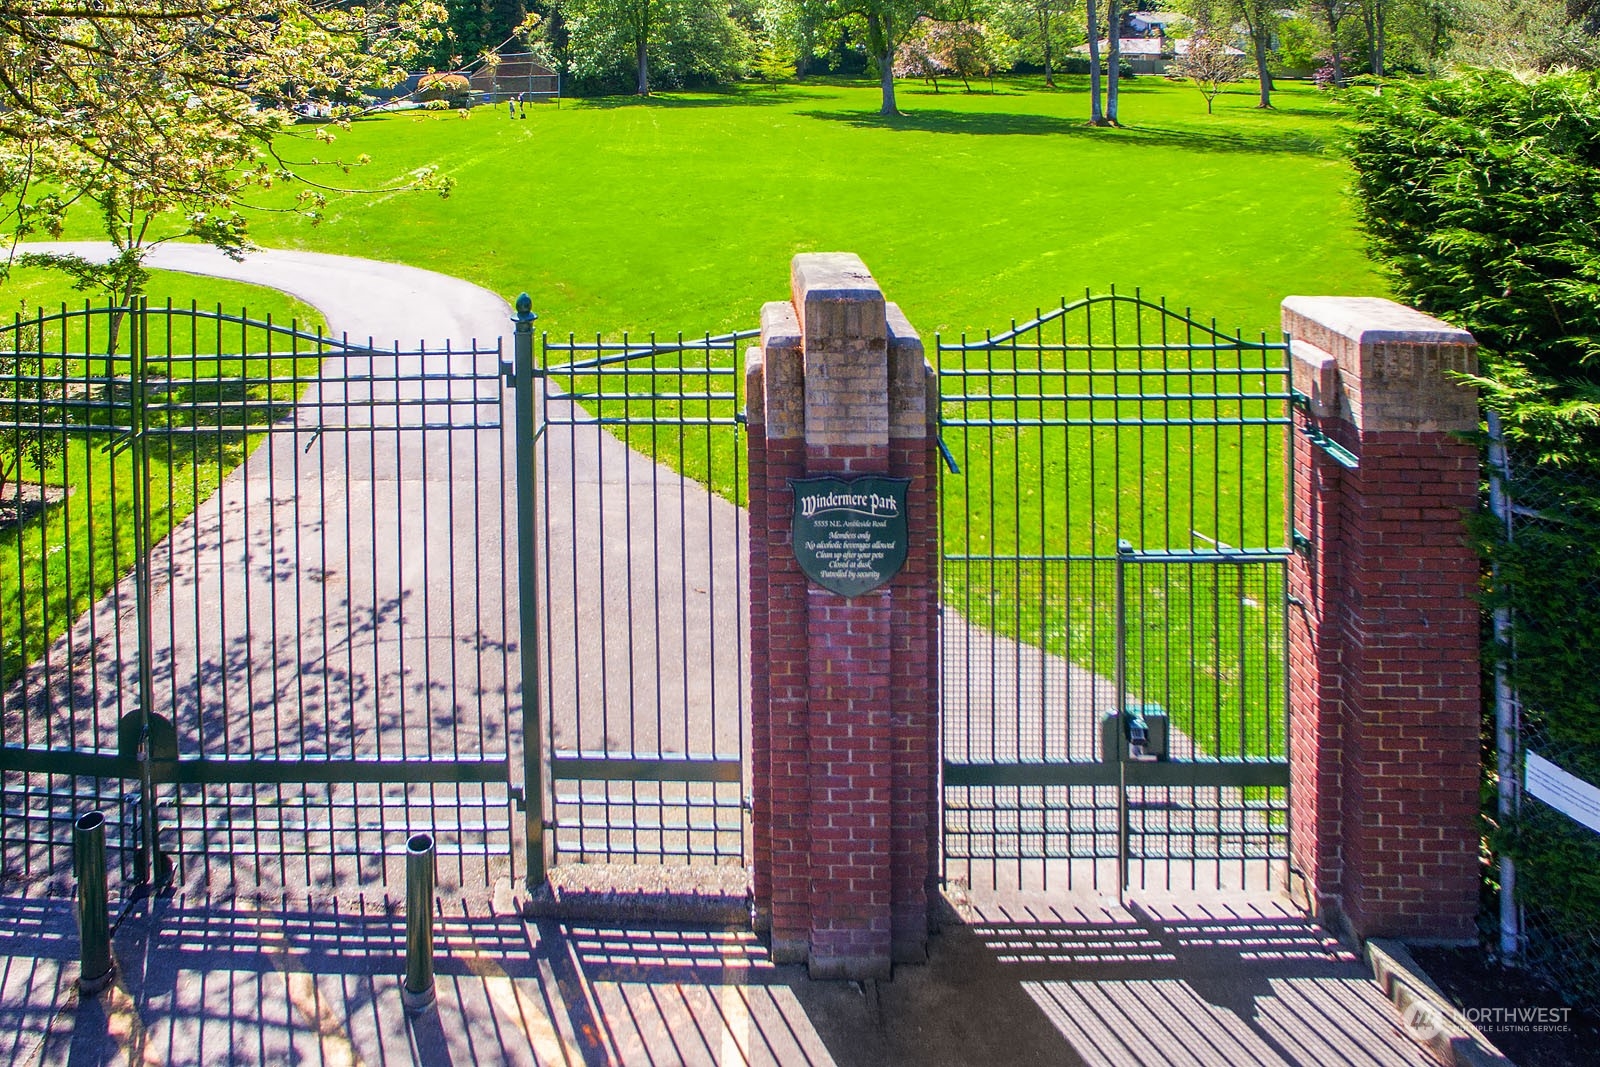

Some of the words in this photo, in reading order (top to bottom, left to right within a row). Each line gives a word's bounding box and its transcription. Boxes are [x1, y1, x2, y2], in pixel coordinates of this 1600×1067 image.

[801, 491, 868, 517] Windermere
[869, 493, 898, 516] Park
[872, 520, 887, 528] Road
[829, 531, 857, 539] Members
[857, 531, 871, 541] only
[805, 541, 816, 550] No
[816, 541, 842, 549] alcoholic
[843, 541, 871, 551] beverages
[871, 541, 896, 549] allowed
[815, 551, 833, 559] Clean
[842, 550, 857, 560] after
[871, 552, 884, 560] pets
[829, 560, 849, 568] Closed
[857, 560, 872, 569] dusk
[820, 570, 847, 578] Patrolled
[847, 570, 856, 580] by
[856, 570, 880, 580] security
